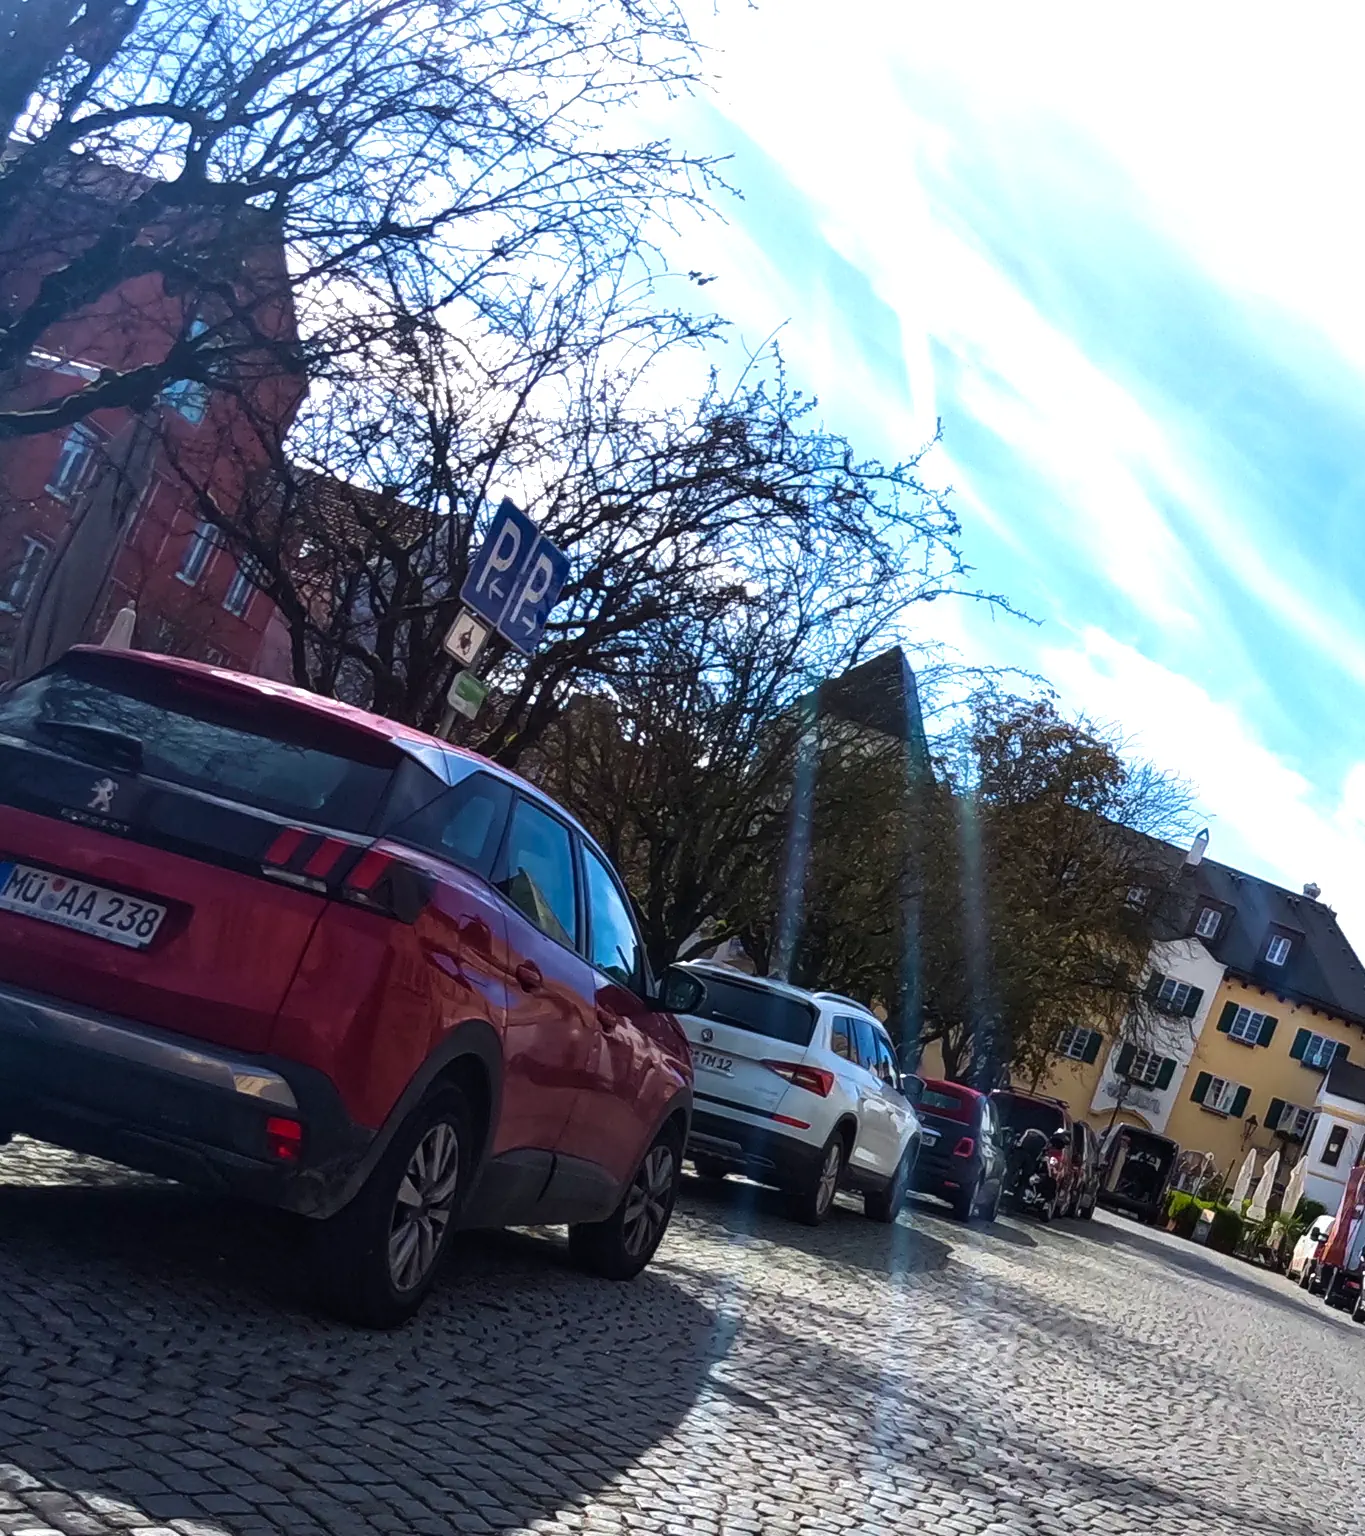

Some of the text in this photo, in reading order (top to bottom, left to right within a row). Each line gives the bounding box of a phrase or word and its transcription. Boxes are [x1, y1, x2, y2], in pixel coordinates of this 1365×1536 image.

[475, 517, 521, 593] P
[509, 552, 553, 623] P
[3, 868, 49, 905] MÜ
[56, 885, 98, 920] AA
[97, 897, 160, 938] 238
[701, 1052, 732, 1071] TM 12
